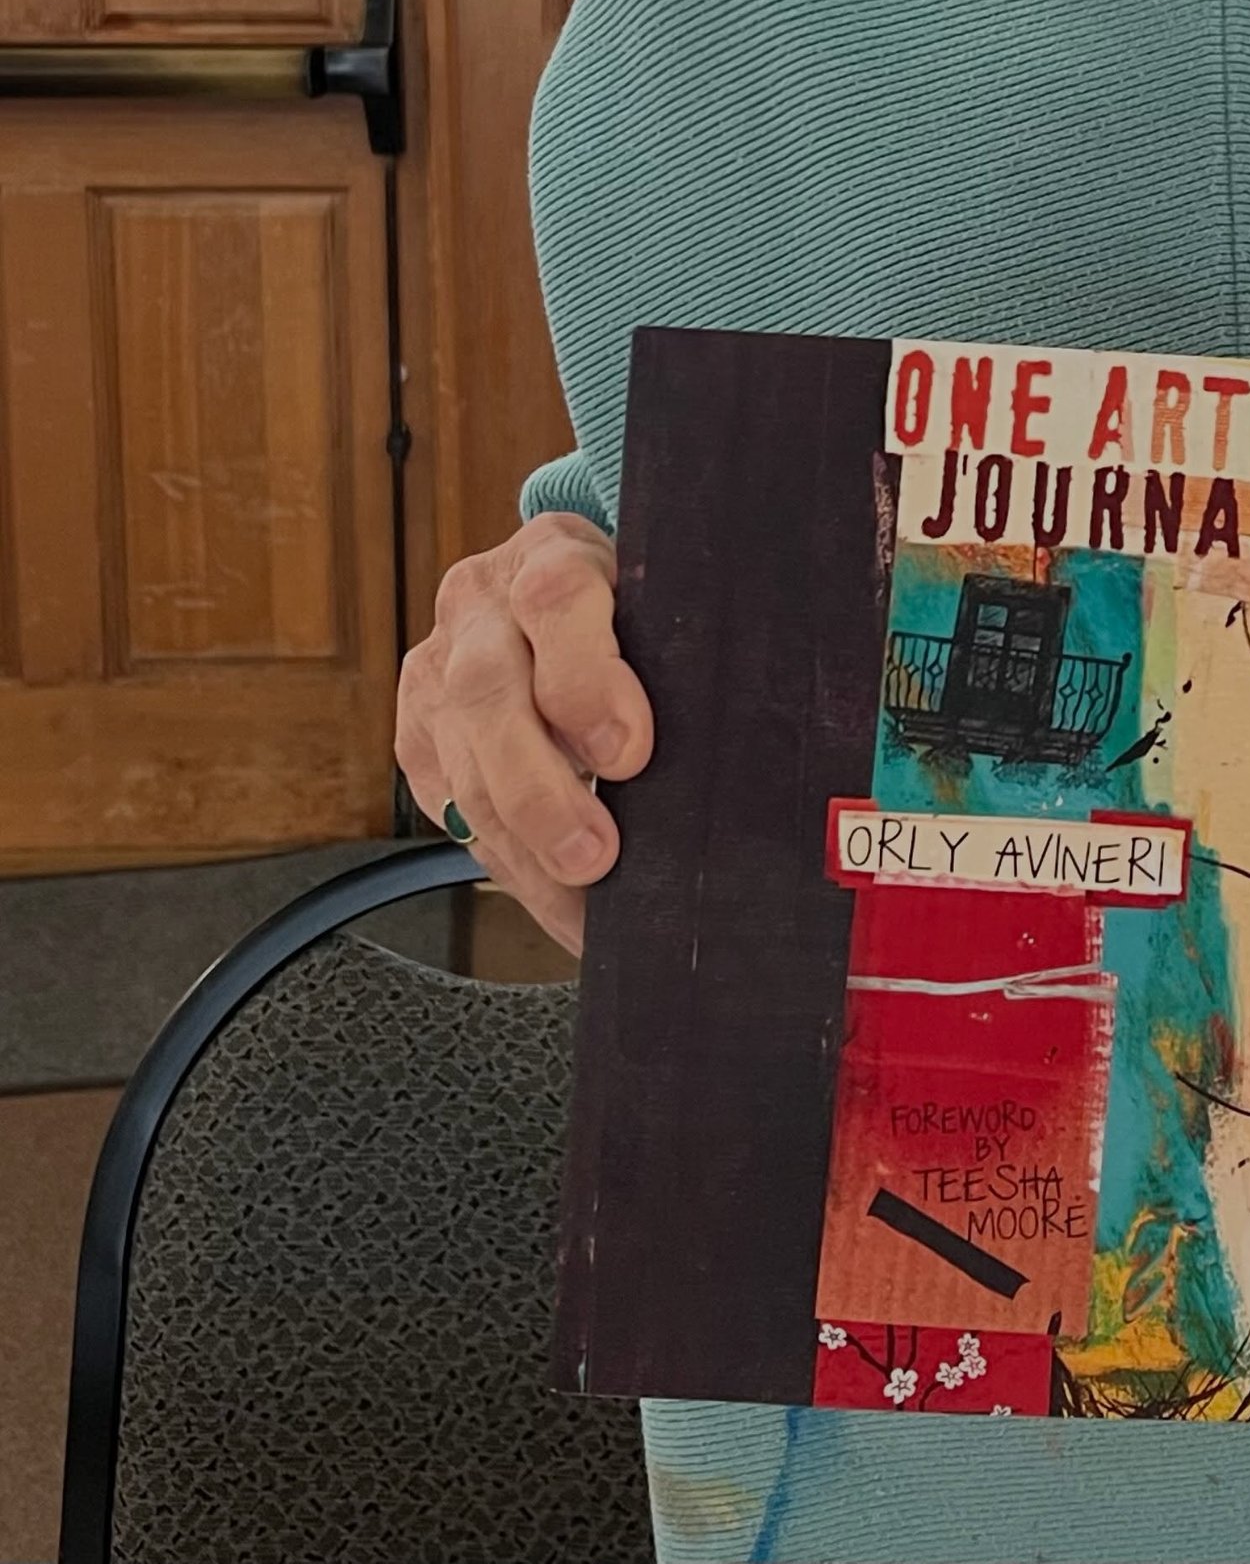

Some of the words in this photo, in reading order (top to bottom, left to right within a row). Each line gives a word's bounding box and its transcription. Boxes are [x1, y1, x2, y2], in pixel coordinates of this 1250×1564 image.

[894, 349, 1052, 458] ONE
[847, 818, 969, 873] ORLY
[995, 833, 1166, 886] AVINERI
[891, 1099, 1036, 1136] FOREWORD
[974, 1135, 1011, 1162] BY
[912, 1164, 1063, 1203] TEESHA
[967, 1198, 1089, 1243] MOORE
